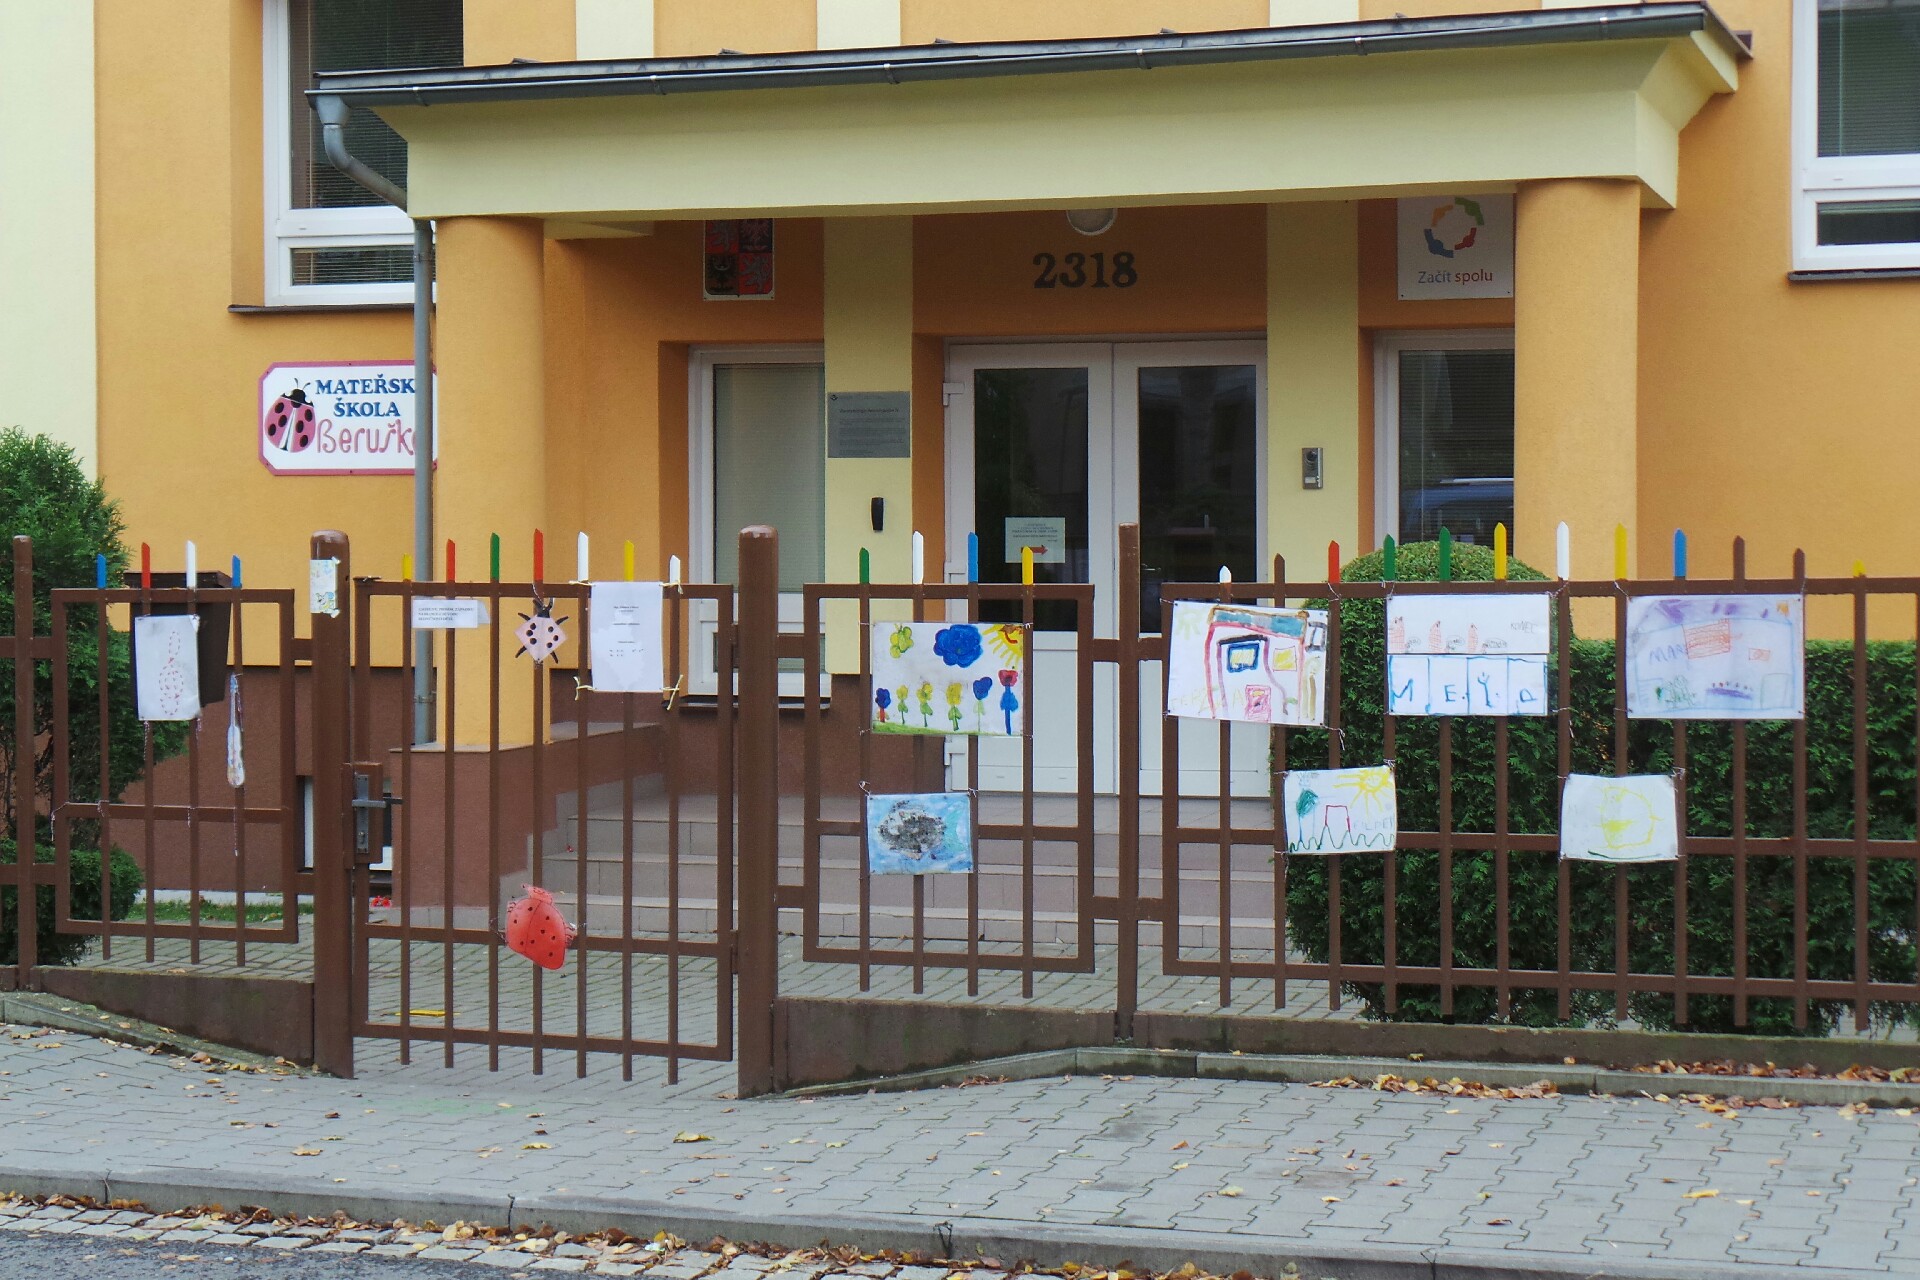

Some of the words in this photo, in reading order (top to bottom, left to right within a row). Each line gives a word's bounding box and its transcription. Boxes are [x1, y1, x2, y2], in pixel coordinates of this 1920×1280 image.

[1033, 252, 1137, 288] 2318
[1418, 270, 1451, 283] Začít
[1455, 269, 1493, 285] spolu
[316, 374, 416, 395] MATEŘSK
[333, 397, 401, 418] ŠKOLA
[316, 418, 416, 456] Berušk
